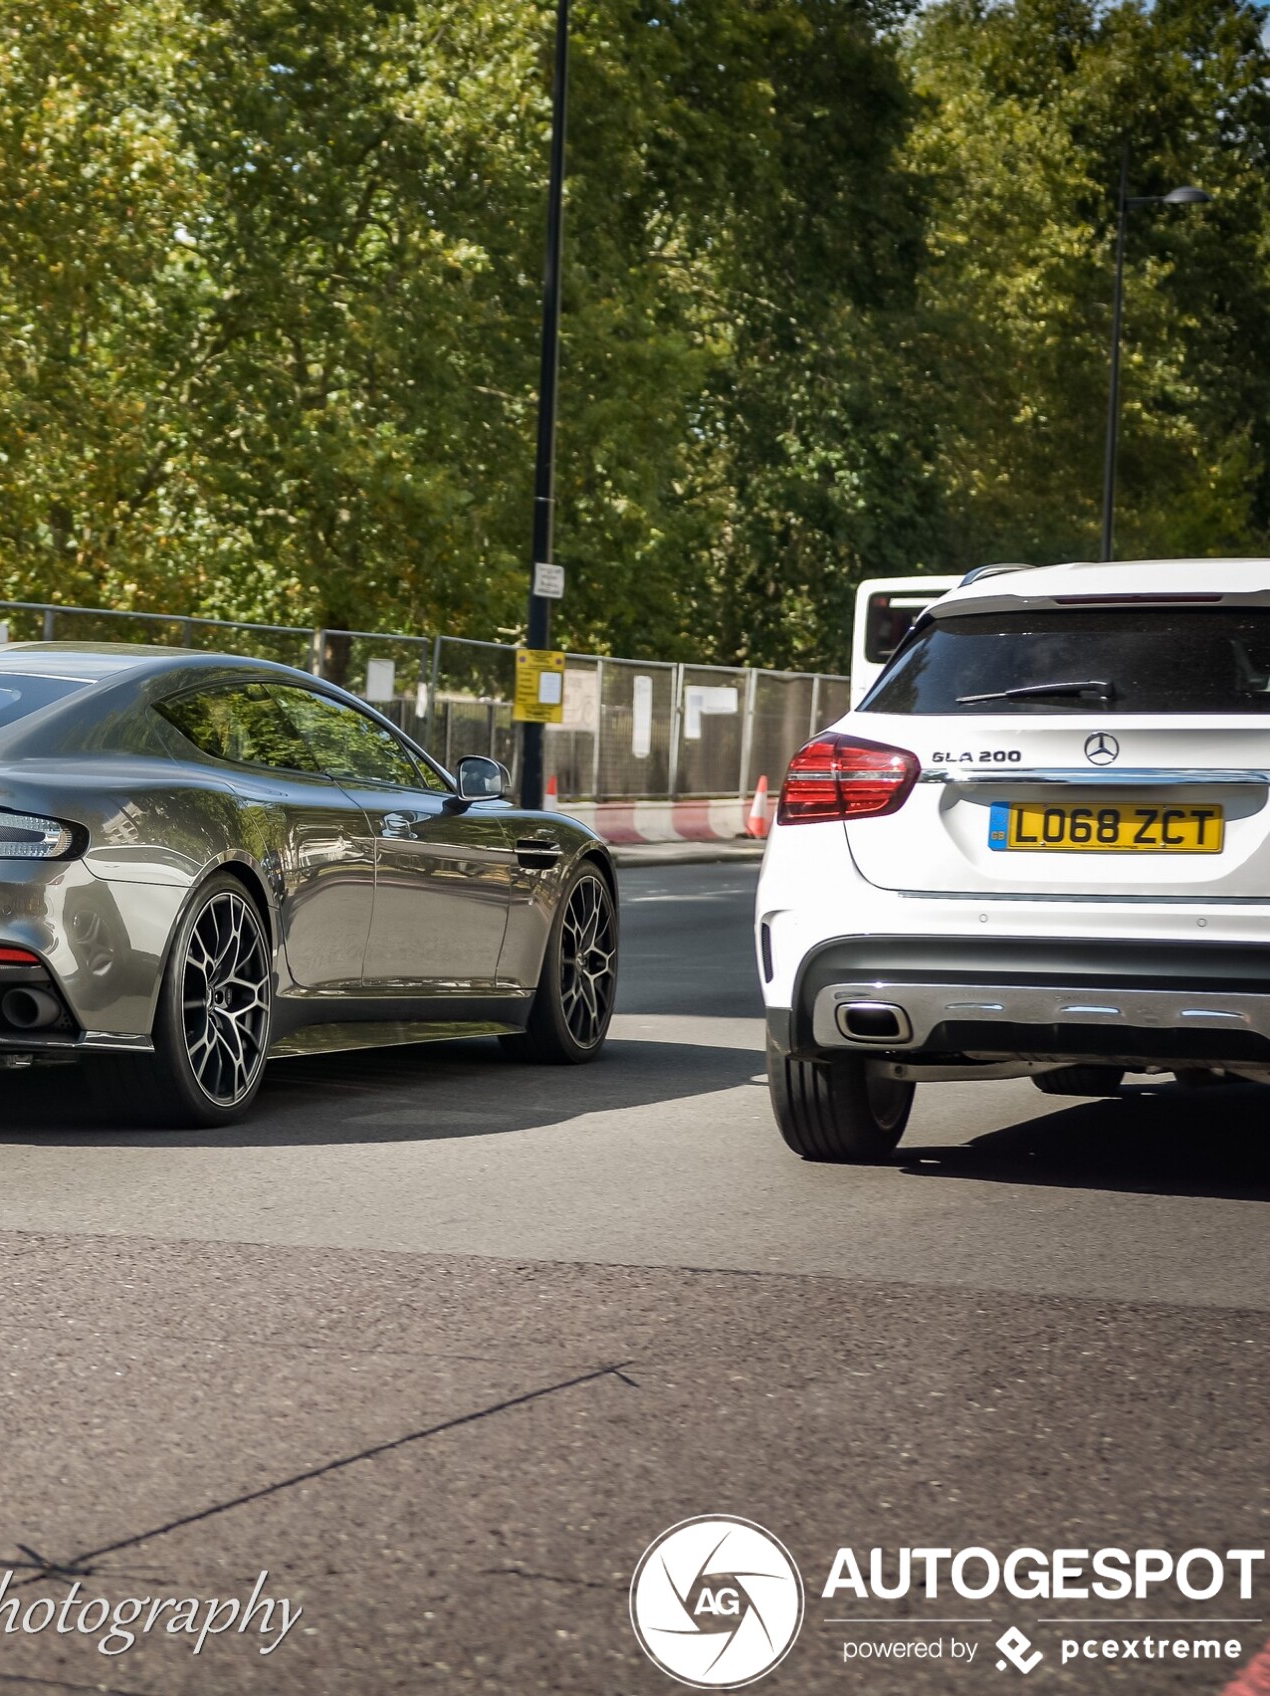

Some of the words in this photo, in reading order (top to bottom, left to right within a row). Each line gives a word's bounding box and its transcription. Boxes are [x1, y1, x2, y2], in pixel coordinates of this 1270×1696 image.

[932, 751, 974, 763] GLA
[978, 750, 1022, 763] 200
[1016, 807, 1121, 844] LO68
[1133, 808, 1215, 845] ZCT
